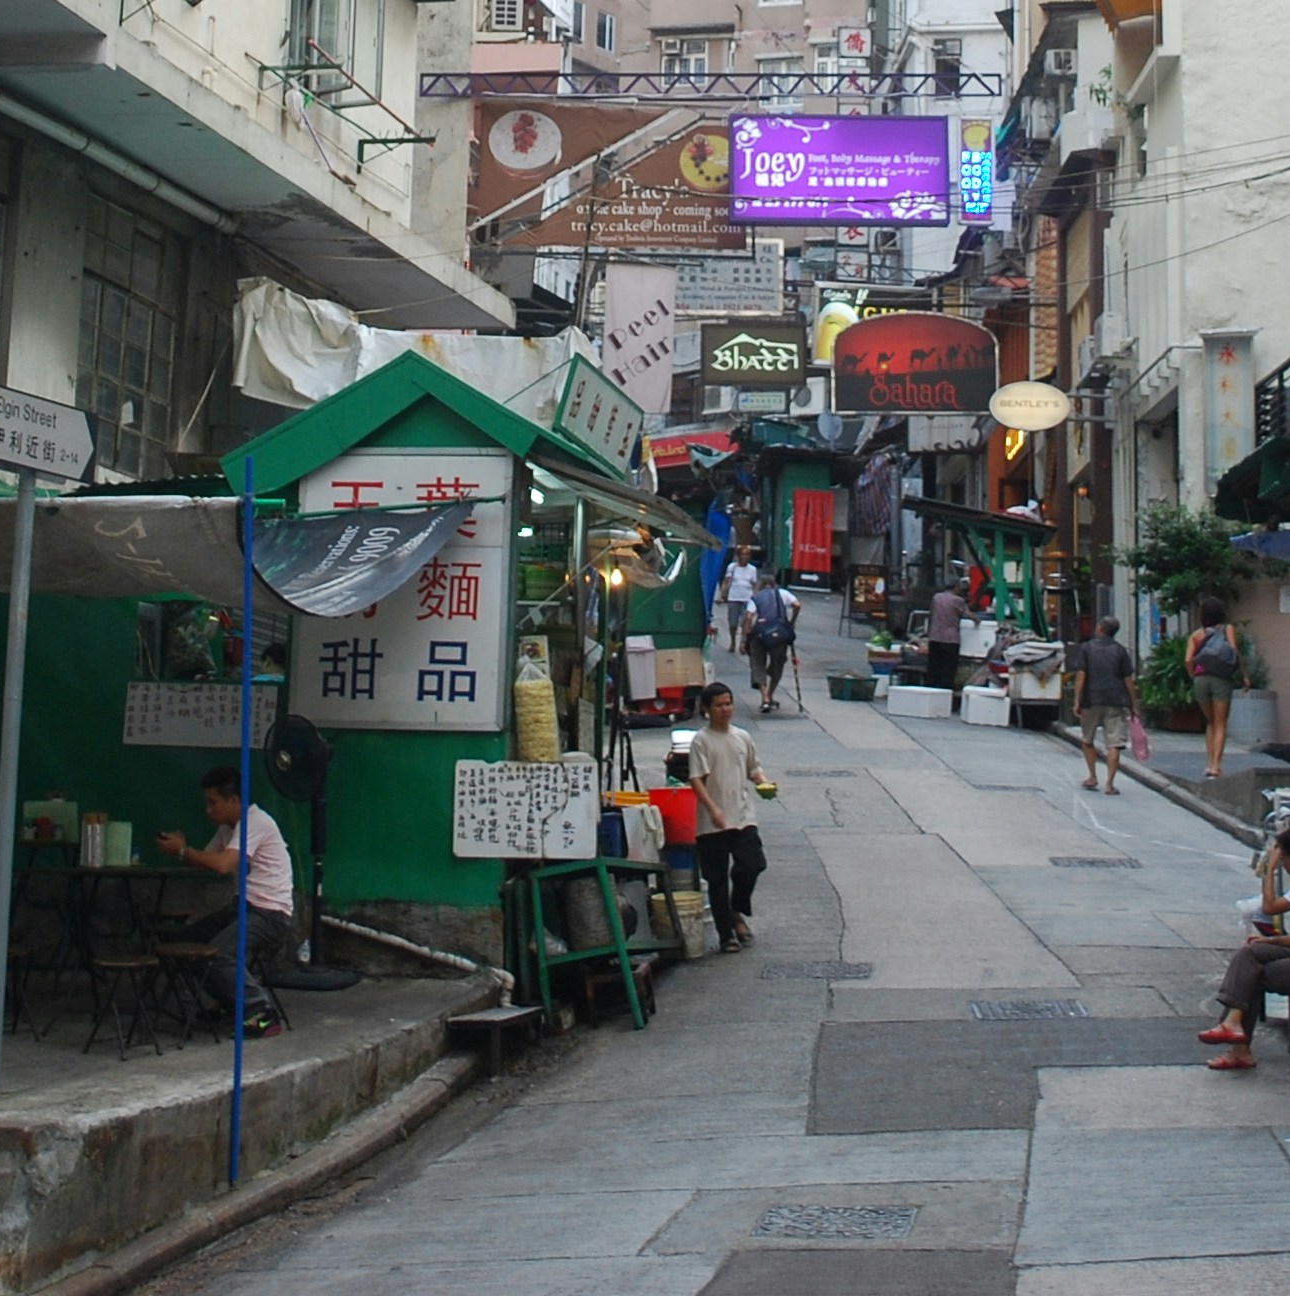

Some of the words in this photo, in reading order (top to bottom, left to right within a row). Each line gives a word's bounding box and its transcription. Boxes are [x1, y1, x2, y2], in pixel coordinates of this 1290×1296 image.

[740, 147, 806, 183] Joey
[854, 154, 891, 167] Massage
[904, 152, 941, 167] Therapy
[611, 201, 635, 215] cake
[637, 201, 663, 221] shop
[673, 203, 712, 221] coming
[608, 298, 670, 350] Peel
[612, 336, 670, 386] Hair
[869, 374, 965, 411] Sahara
[999, 399, 1060, 409] BENTLEY'S
[22, 404, 57, 429] Street
[319, 638, 477, 703] 甜品
